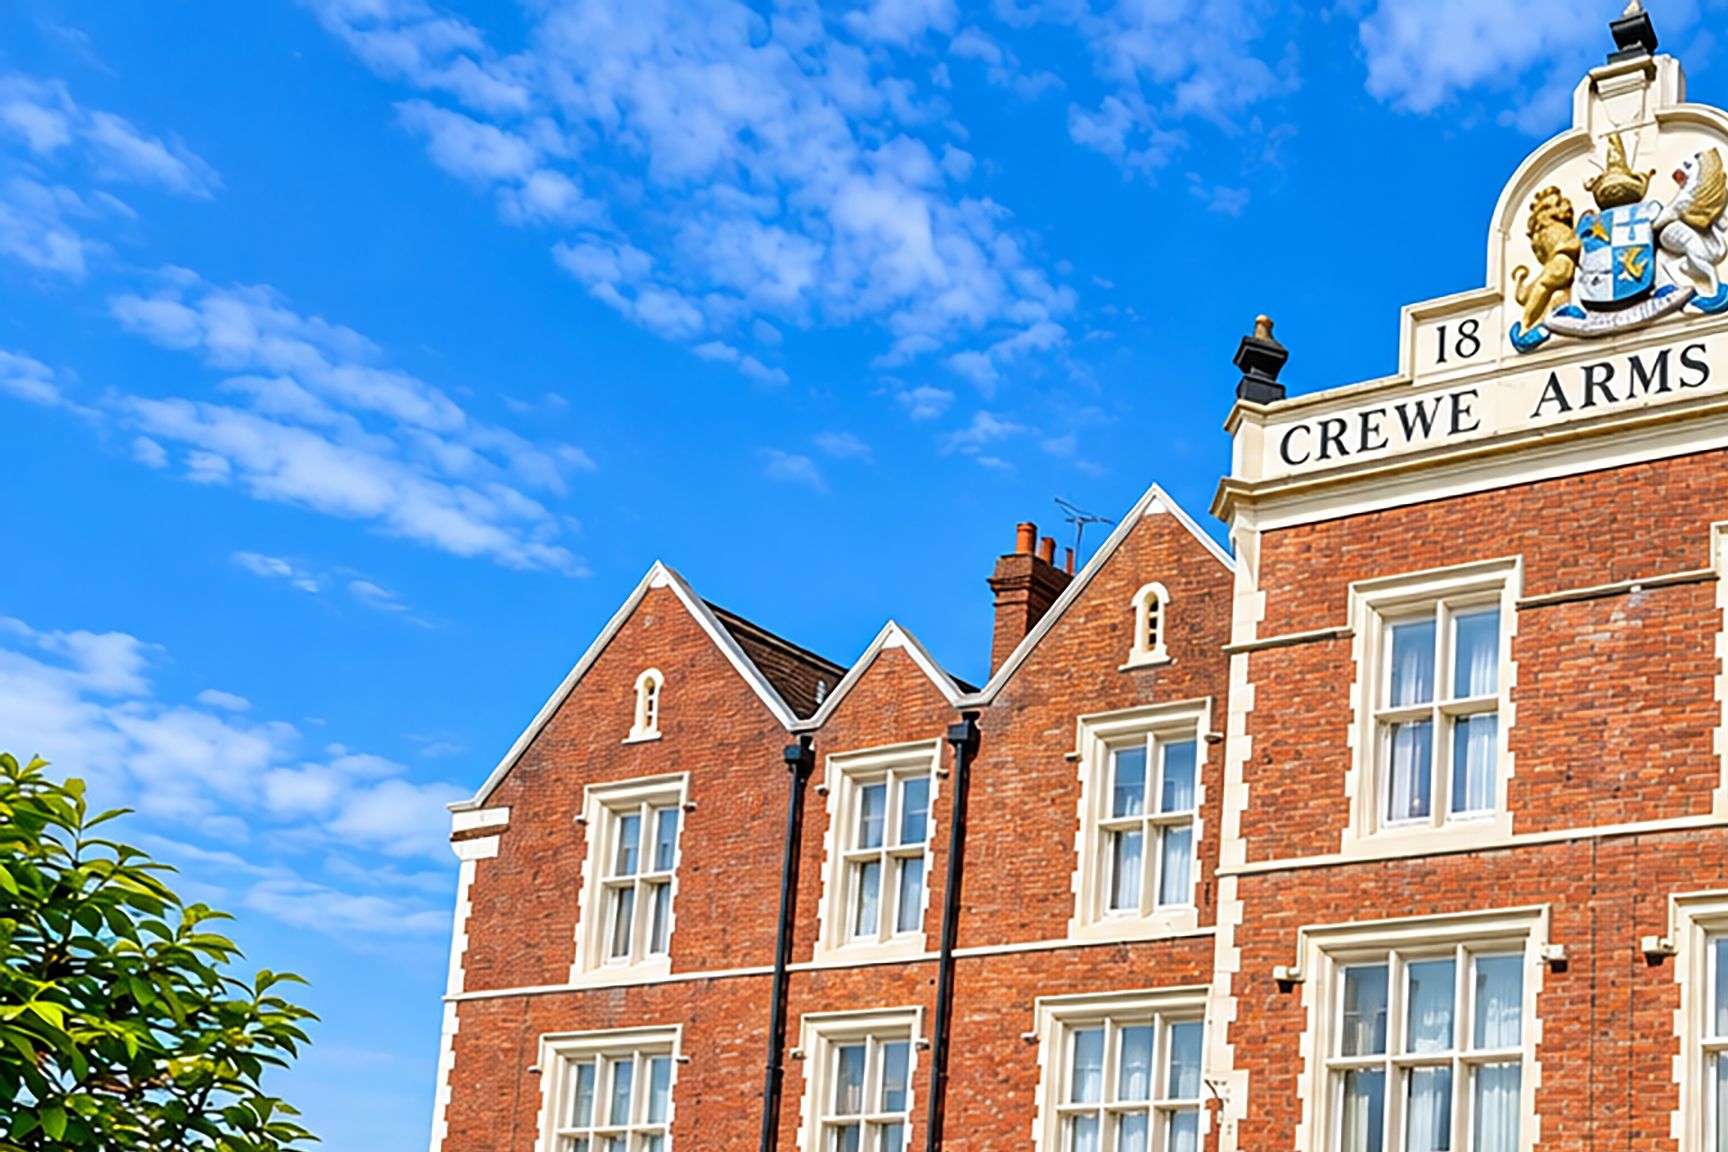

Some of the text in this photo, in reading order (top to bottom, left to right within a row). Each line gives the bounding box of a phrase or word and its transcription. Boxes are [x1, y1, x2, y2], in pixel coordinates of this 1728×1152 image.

[1436, 319, 1481, 363] 18
[1279, 389, 1480, 465] CREWE
[1531, 344, 1710, 418] ARMS
